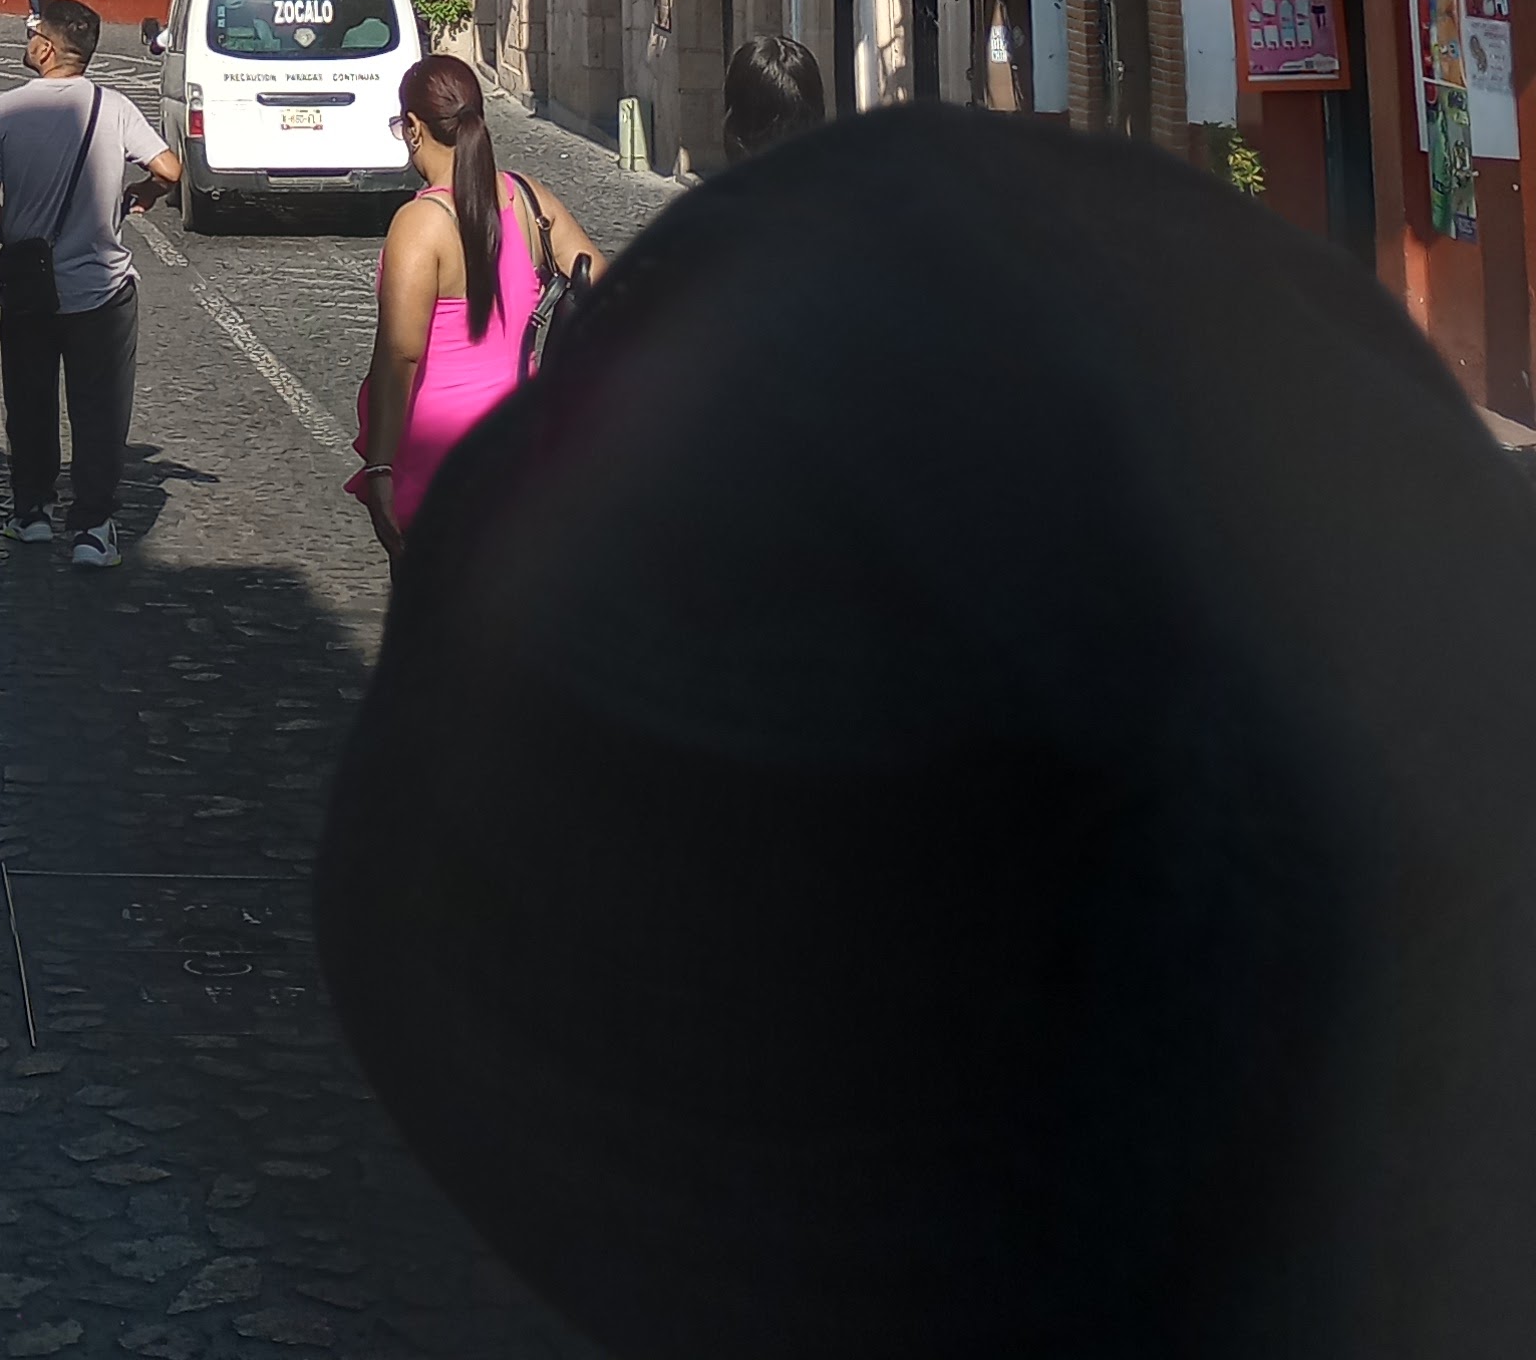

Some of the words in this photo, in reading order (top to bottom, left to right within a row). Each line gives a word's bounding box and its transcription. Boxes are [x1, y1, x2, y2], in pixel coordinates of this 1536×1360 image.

[273, 0, 333, 23] ZOCALO
[223, 73, 277, 82] PRECAUCION
[332, 73, 380, 82] CONTINUAS
